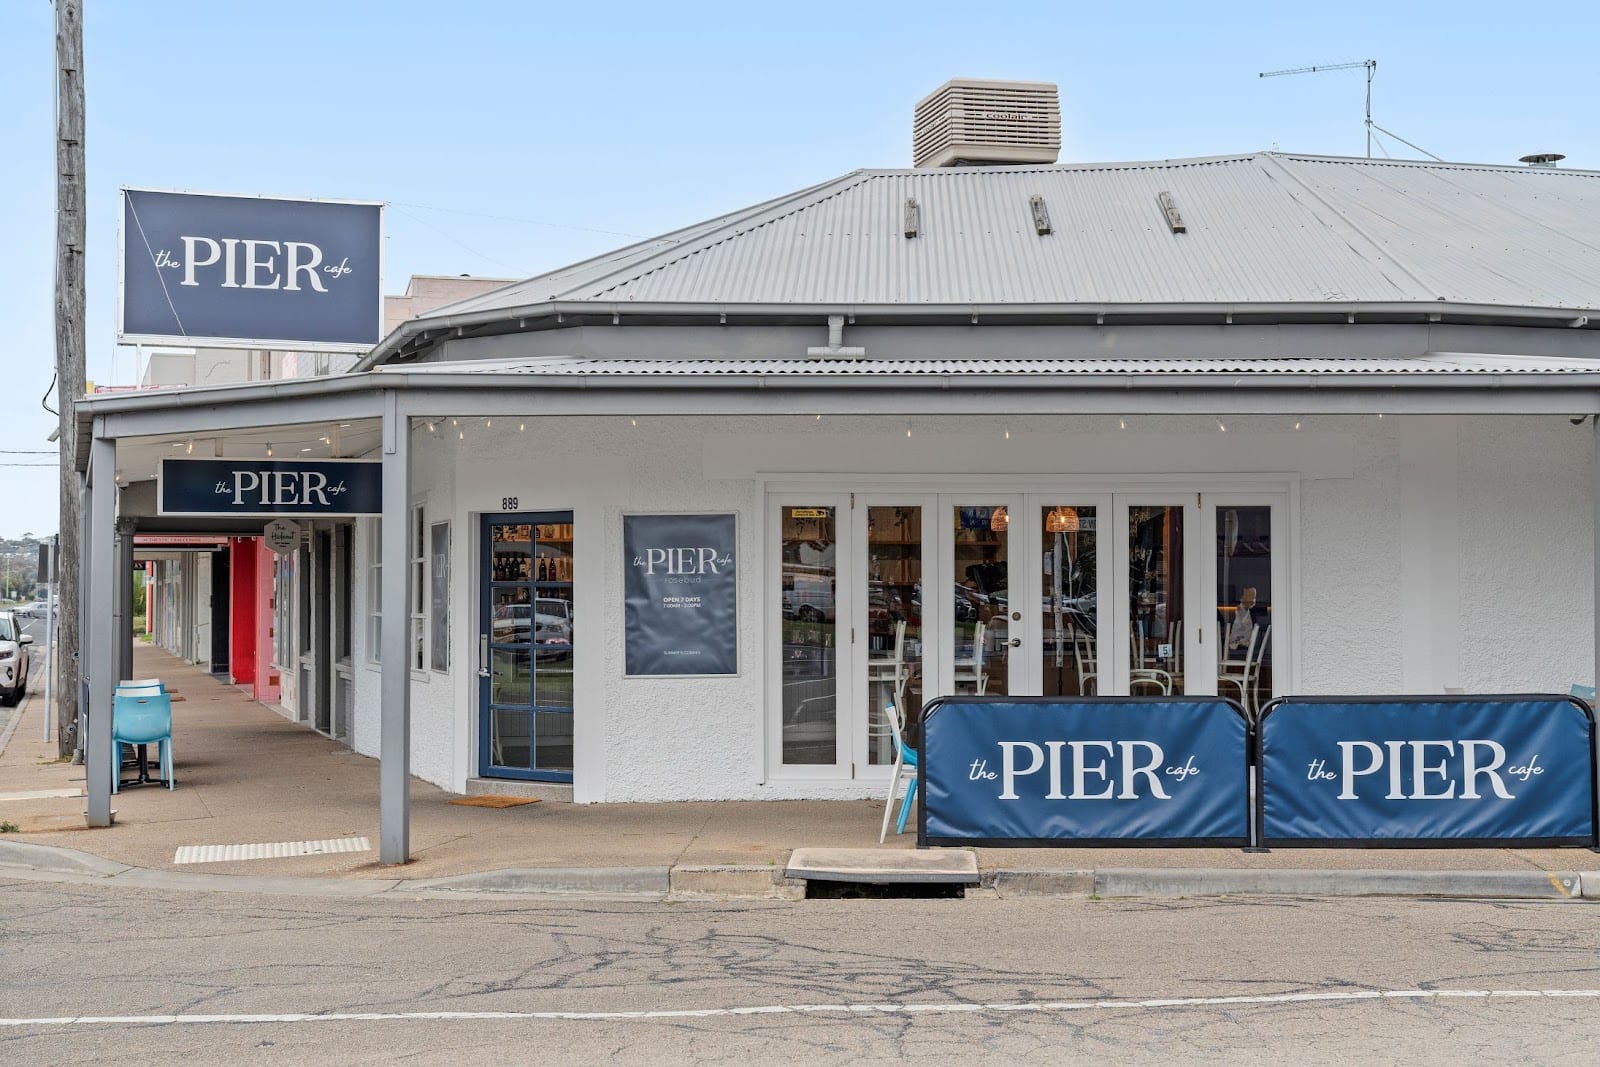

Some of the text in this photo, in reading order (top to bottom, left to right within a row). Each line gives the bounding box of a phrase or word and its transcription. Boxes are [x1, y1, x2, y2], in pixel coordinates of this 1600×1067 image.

[986, 112, 1026, 120] coolair
[155, 236, 353, 293] the PIER cafe
[214, 471, 347, 506] the PIER cafe
[502, 496, 518, 510] 889
[633, 547, 732, 575] the PIER cafe
[664, 576, 702, 584] rosebud
[1162, 646, 1168, 655] 5
[969, 740, 1200, 800] the PIER cafe
[1307, 739, 1545, 800] the PIER cafe
